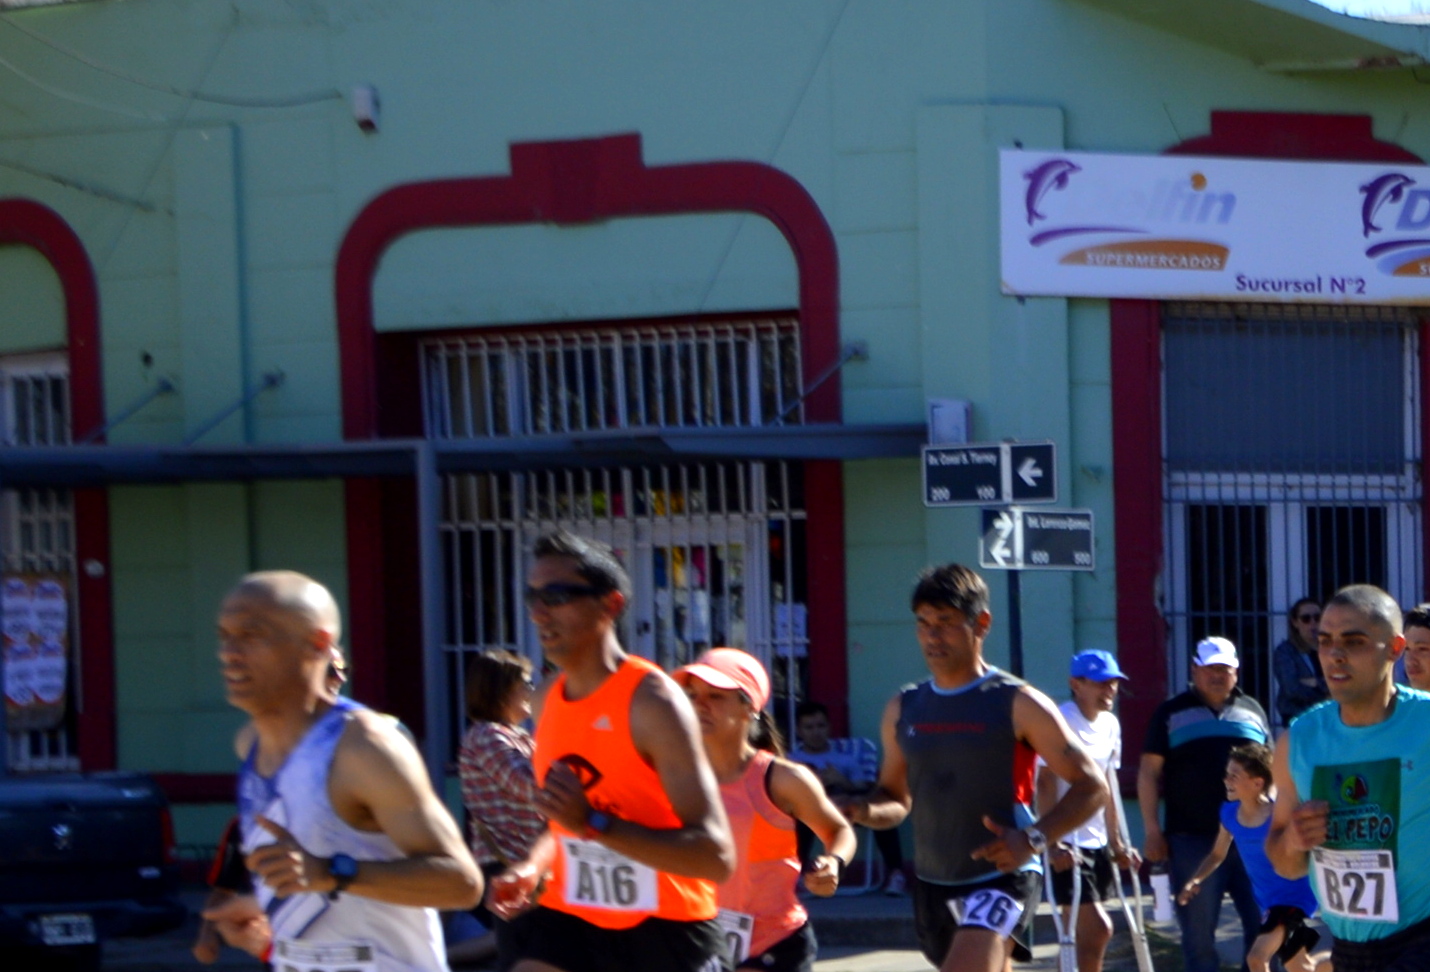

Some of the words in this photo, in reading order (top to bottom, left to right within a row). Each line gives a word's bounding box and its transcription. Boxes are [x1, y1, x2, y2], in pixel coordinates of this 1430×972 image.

[1086, 252, 1222, 269] SUPERMERCADOS
[1235, 274, 1323, 294] Sucursal
[1330, 278, 1367, 295] N°2
[1344, 814, 1393, 842] PEPO
[576, 861, 639, 905] A16
[1323, 867, 1387, 917] B27
